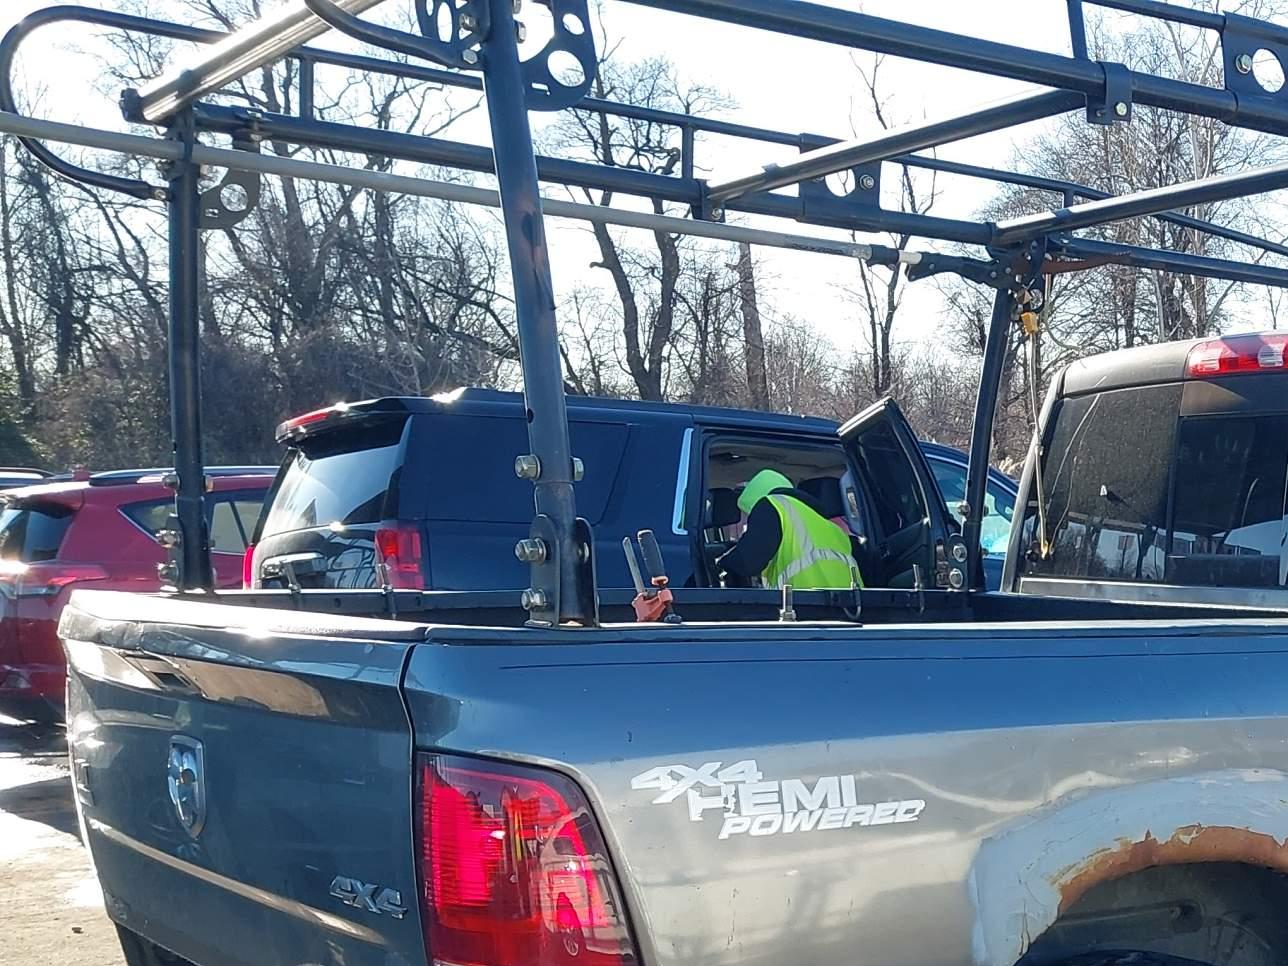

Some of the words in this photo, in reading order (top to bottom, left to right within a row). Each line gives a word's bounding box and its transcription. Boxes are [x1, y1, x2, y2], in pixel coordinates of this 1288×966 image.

[631, 759, 763, 804] 4X4
[687, 774, 858, 821] HEMI
[718, 800, 926, 840] POWERED
[329, 875, 408, 919] 4X4
